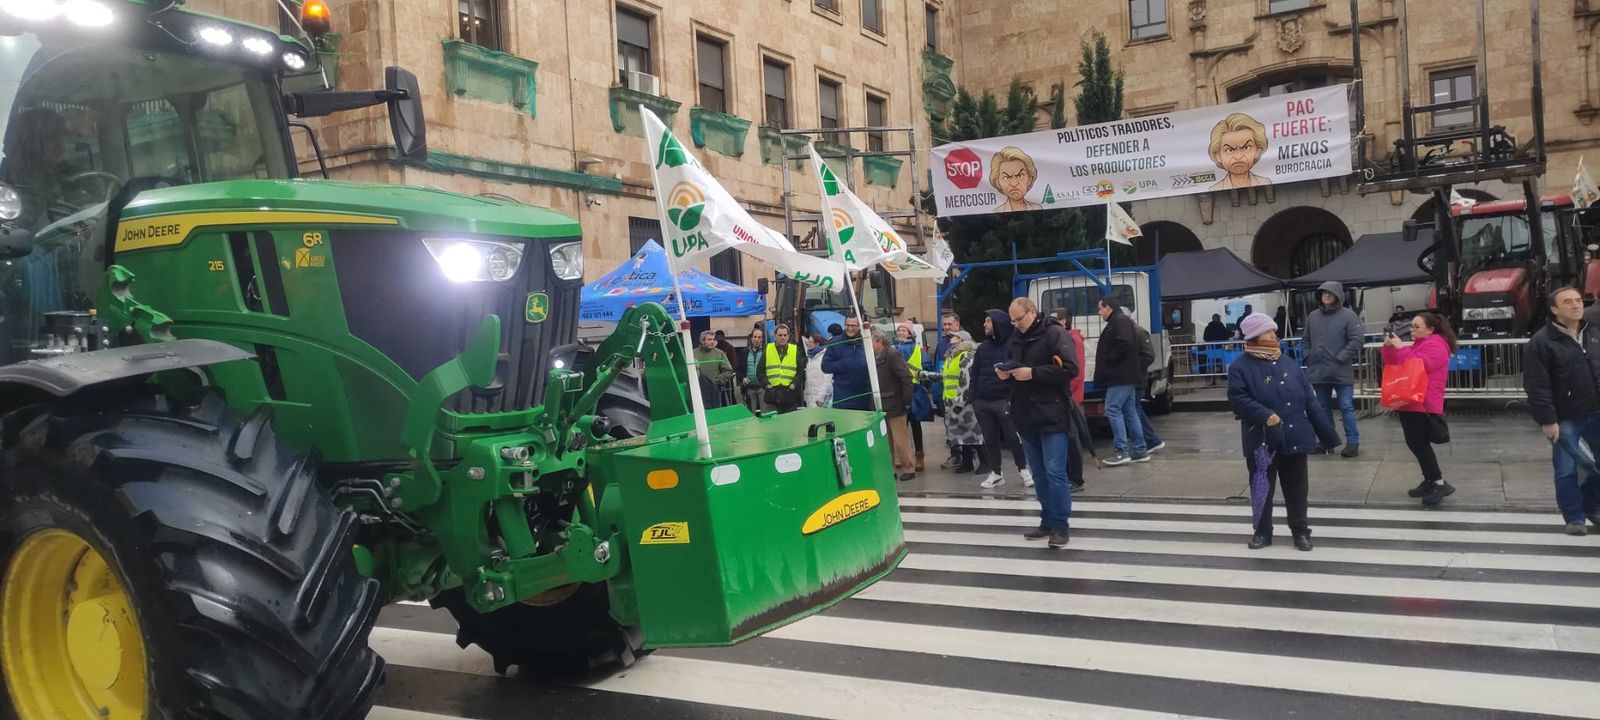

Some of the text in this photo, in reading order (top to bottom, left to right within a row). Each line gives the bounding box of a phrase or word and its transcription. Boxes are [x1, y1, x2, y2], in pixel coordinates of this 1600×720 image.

[1286, 98, 1315, 117] PAC
[1057, 116, 1175, 144] POLÍTICOS TRAIDORES,
[1272, 116, 1332, 138] FUERTE;
[1086, 138, 1150, 158] DEFENDER A
[1278, 139, 1329, 160] MENOS
[946, 160, 981, 178] STOP
[1070, 165, 1089, 178] LOS
[1090, 155, 1166, 175] PRODUCTORES
[1275, 158, 1332, 175] BUROCRACIA
[1139, 179, 1158, 189] UPA
[944, 192, 997, 209] MERCOSUR
[122, 223, 181, 241] JOHN DEERE
[303, 232, 323, 247] 6R
[733, 224, 760, 245] UNIO
[672, 231, 709, 258] UPA
[208, 260, 224, 271] 215
[822, 498, 870, 527] JOHN DEERE
